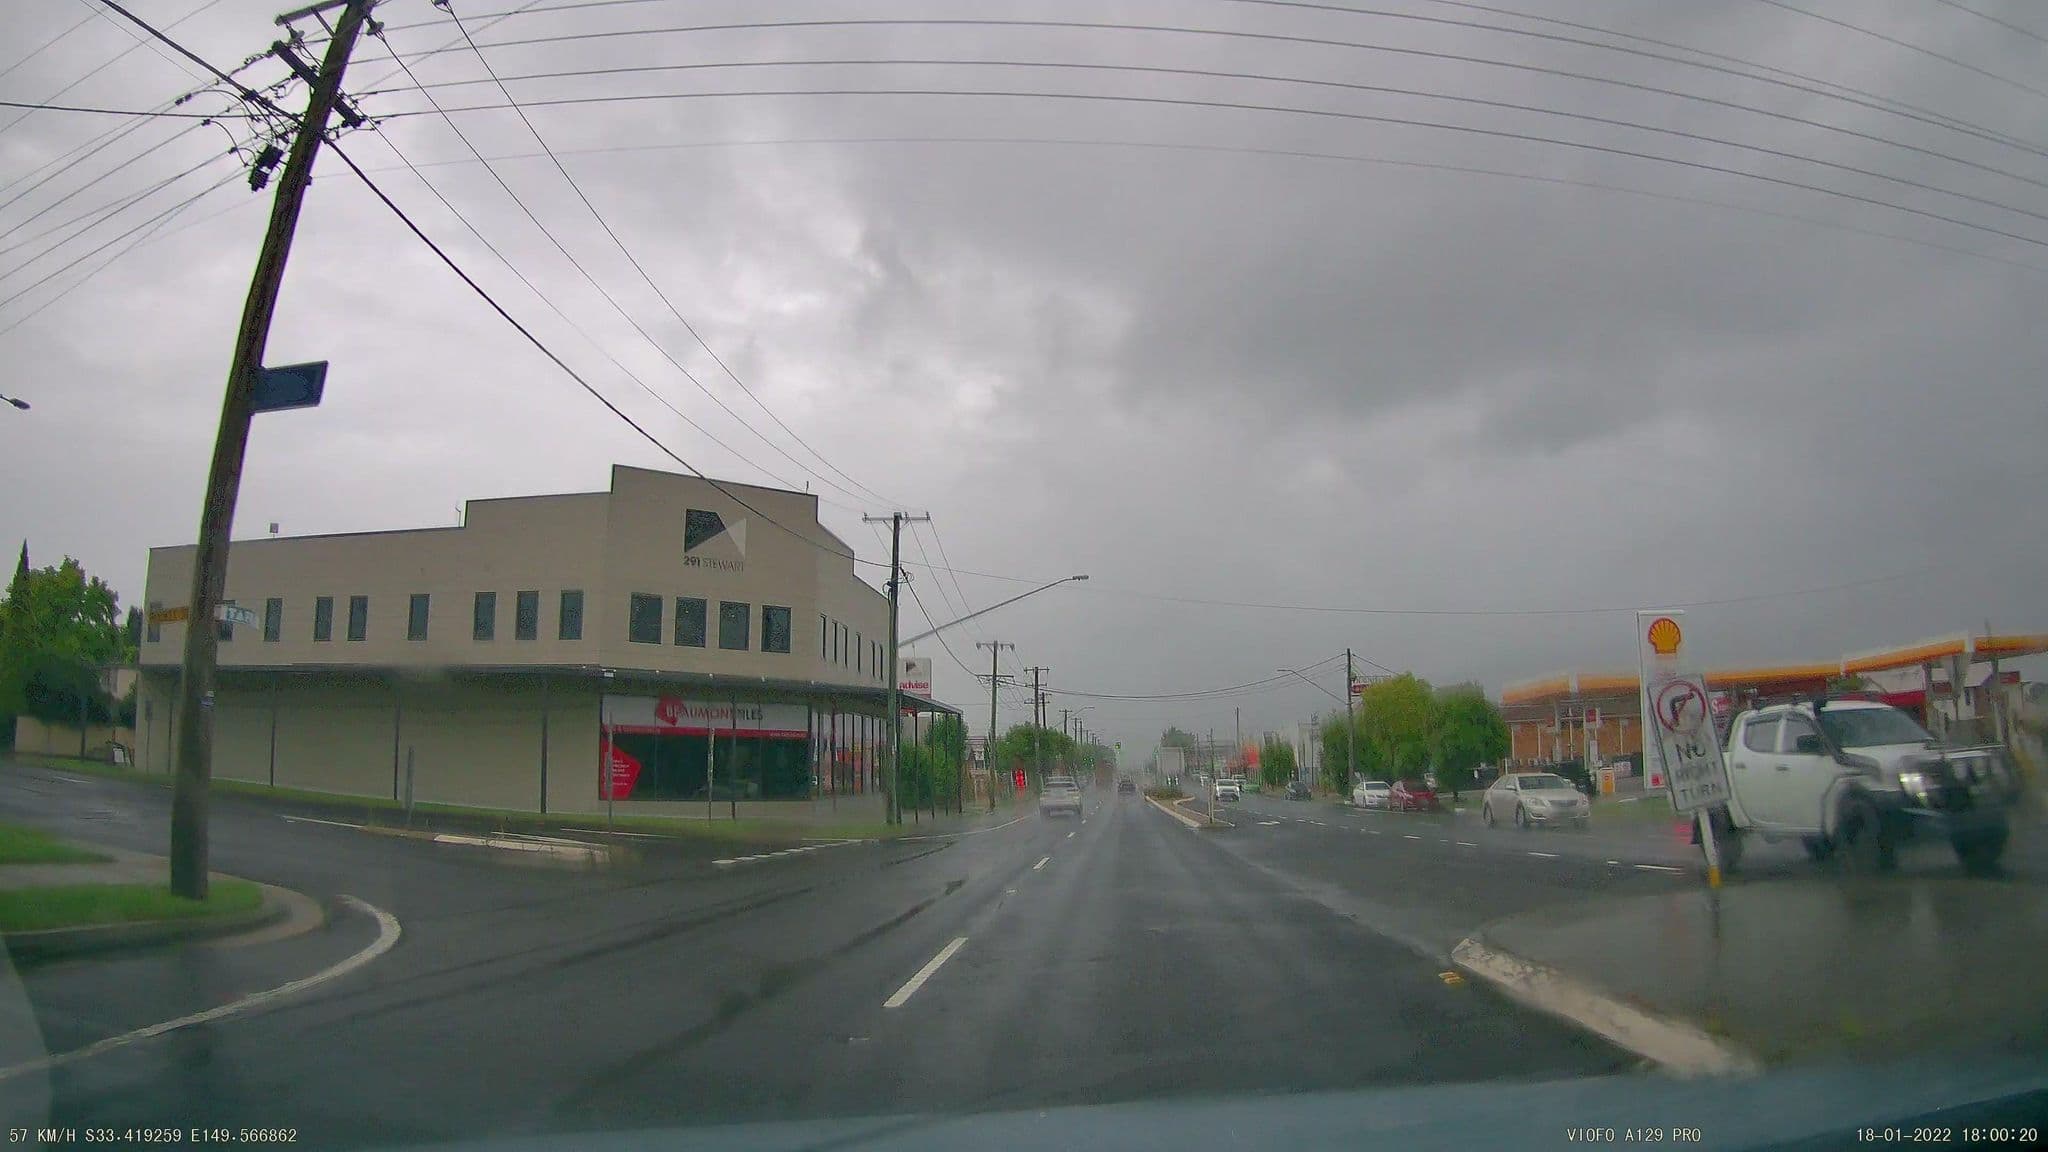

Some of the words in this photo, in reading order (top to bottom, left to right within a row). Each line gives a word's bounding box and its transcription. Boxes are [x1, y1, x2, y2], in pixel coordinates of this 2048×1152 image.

[683, 555, 700, 566] 291
[703, 559, 743, 572] STEWART
[1675, 742, 1706, 763] NO
[1680, 783, 1722, 802] TURN
